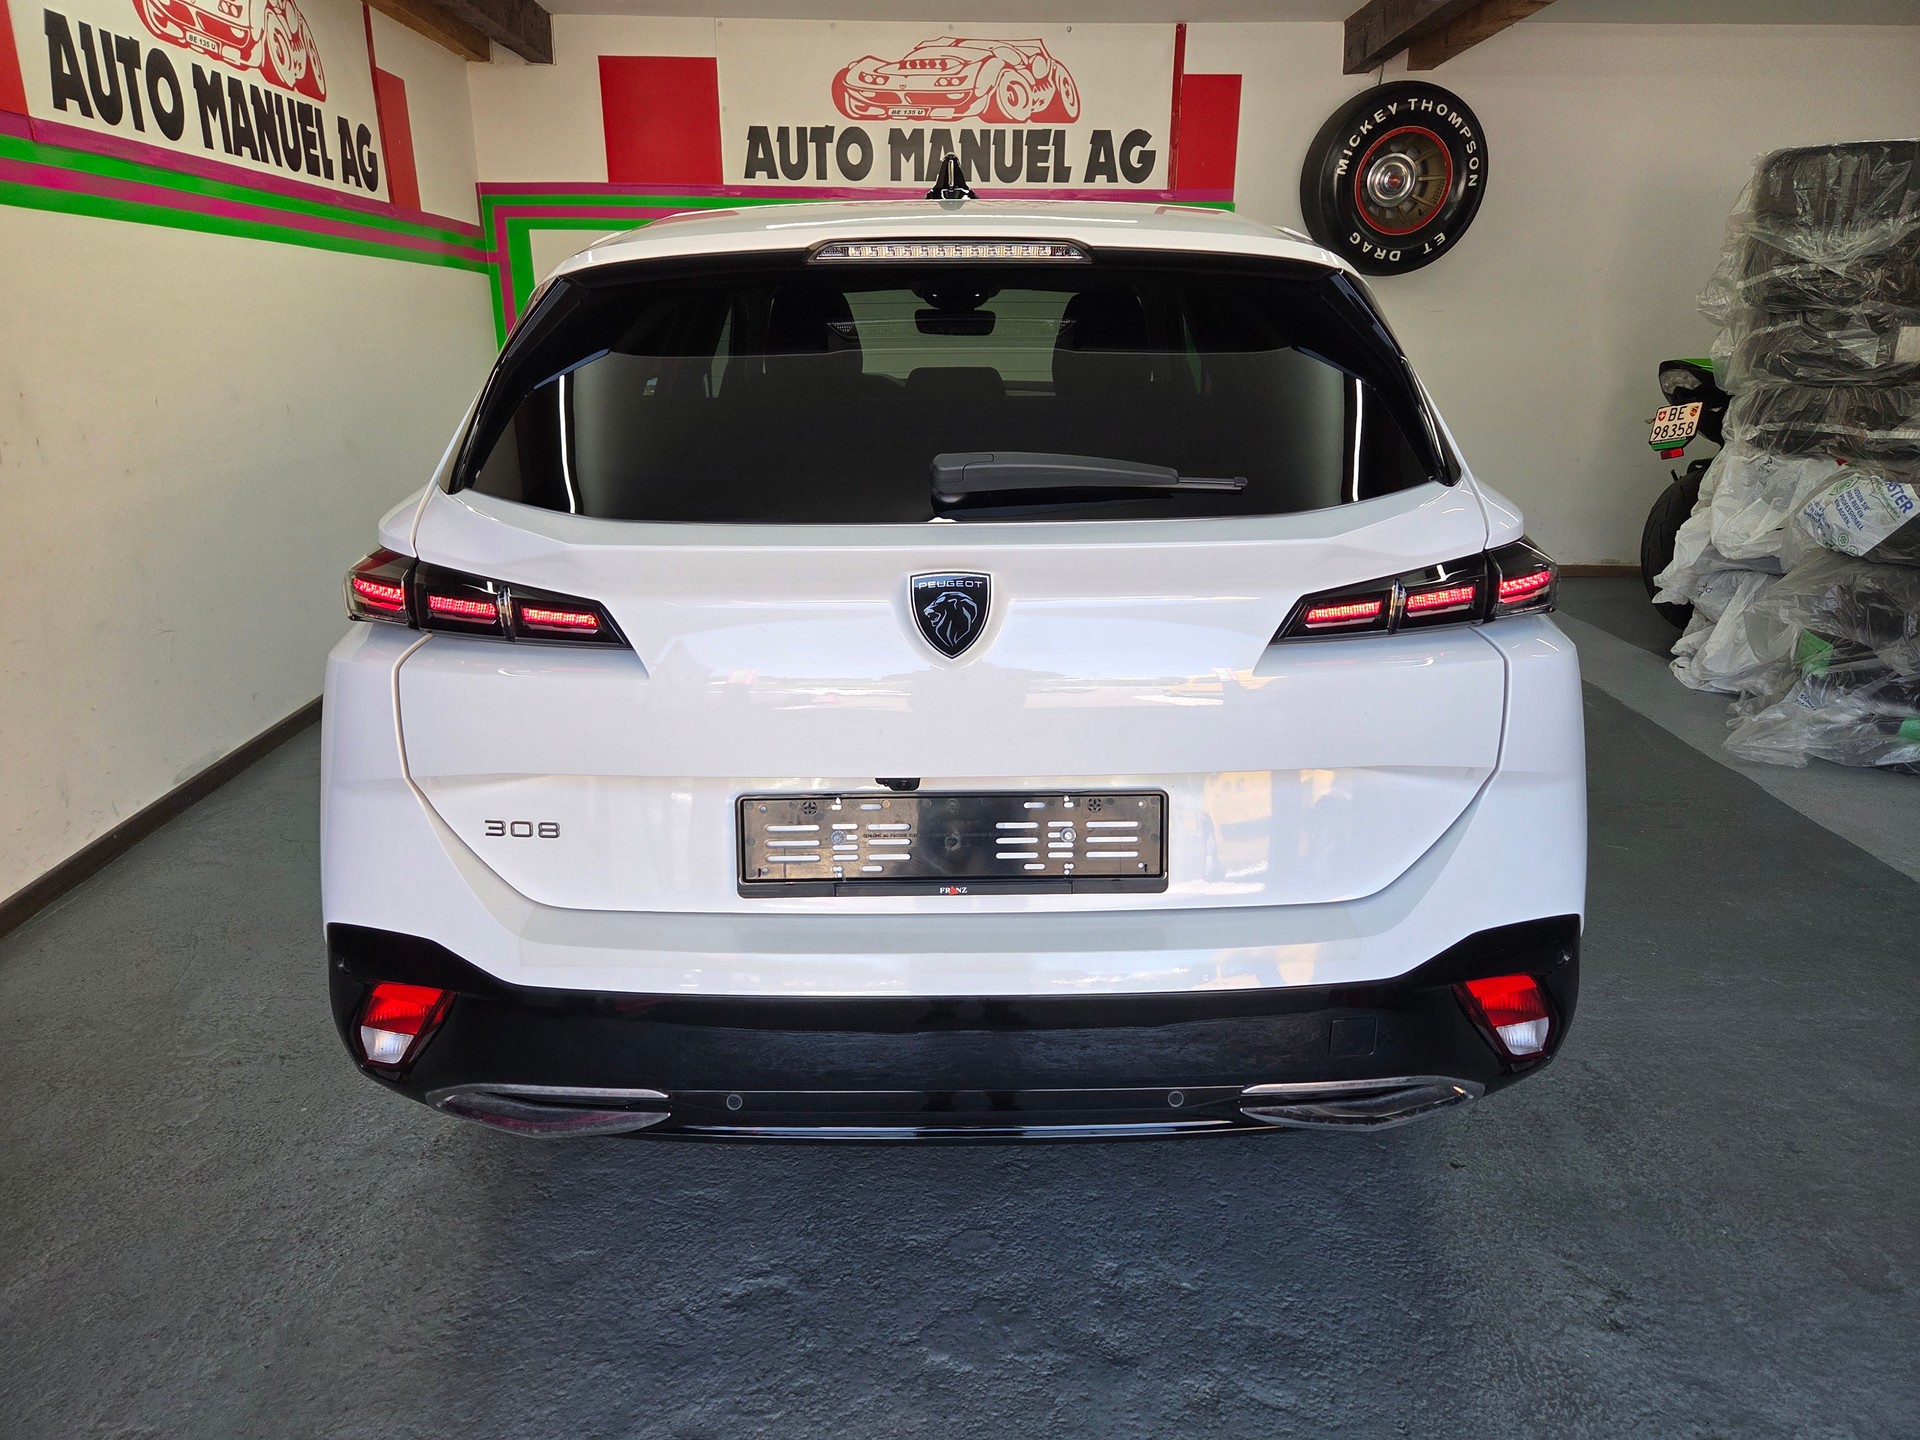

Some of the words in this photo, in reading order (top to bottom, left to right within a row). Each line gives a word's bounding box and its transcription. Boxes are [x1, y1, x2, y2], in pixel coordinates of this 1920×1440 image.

[44, 7, 185, 142] AUTO
[192, 63, 334, 181] MANUEL
[337, 116, 379, 193] AG
[1336, 102, 1399, 176] MICKEY
[1408, 98, 1480, 187] THOMPSON
[744, 125, 874, 182] AUTO
[887, 127, 1072, 184] MANUEL
[1083, 128, 1157, 184] AG
[1349, 232, 1401, 262] DRAG
[1422, 232, 1447, 255] ET
[1668, 405, 1687, 422] BE
[1653, 421, 1694, 440] 98358
[918, 580, 983, 590] PEUGEOT
[484, 819, 561, 839] 308
